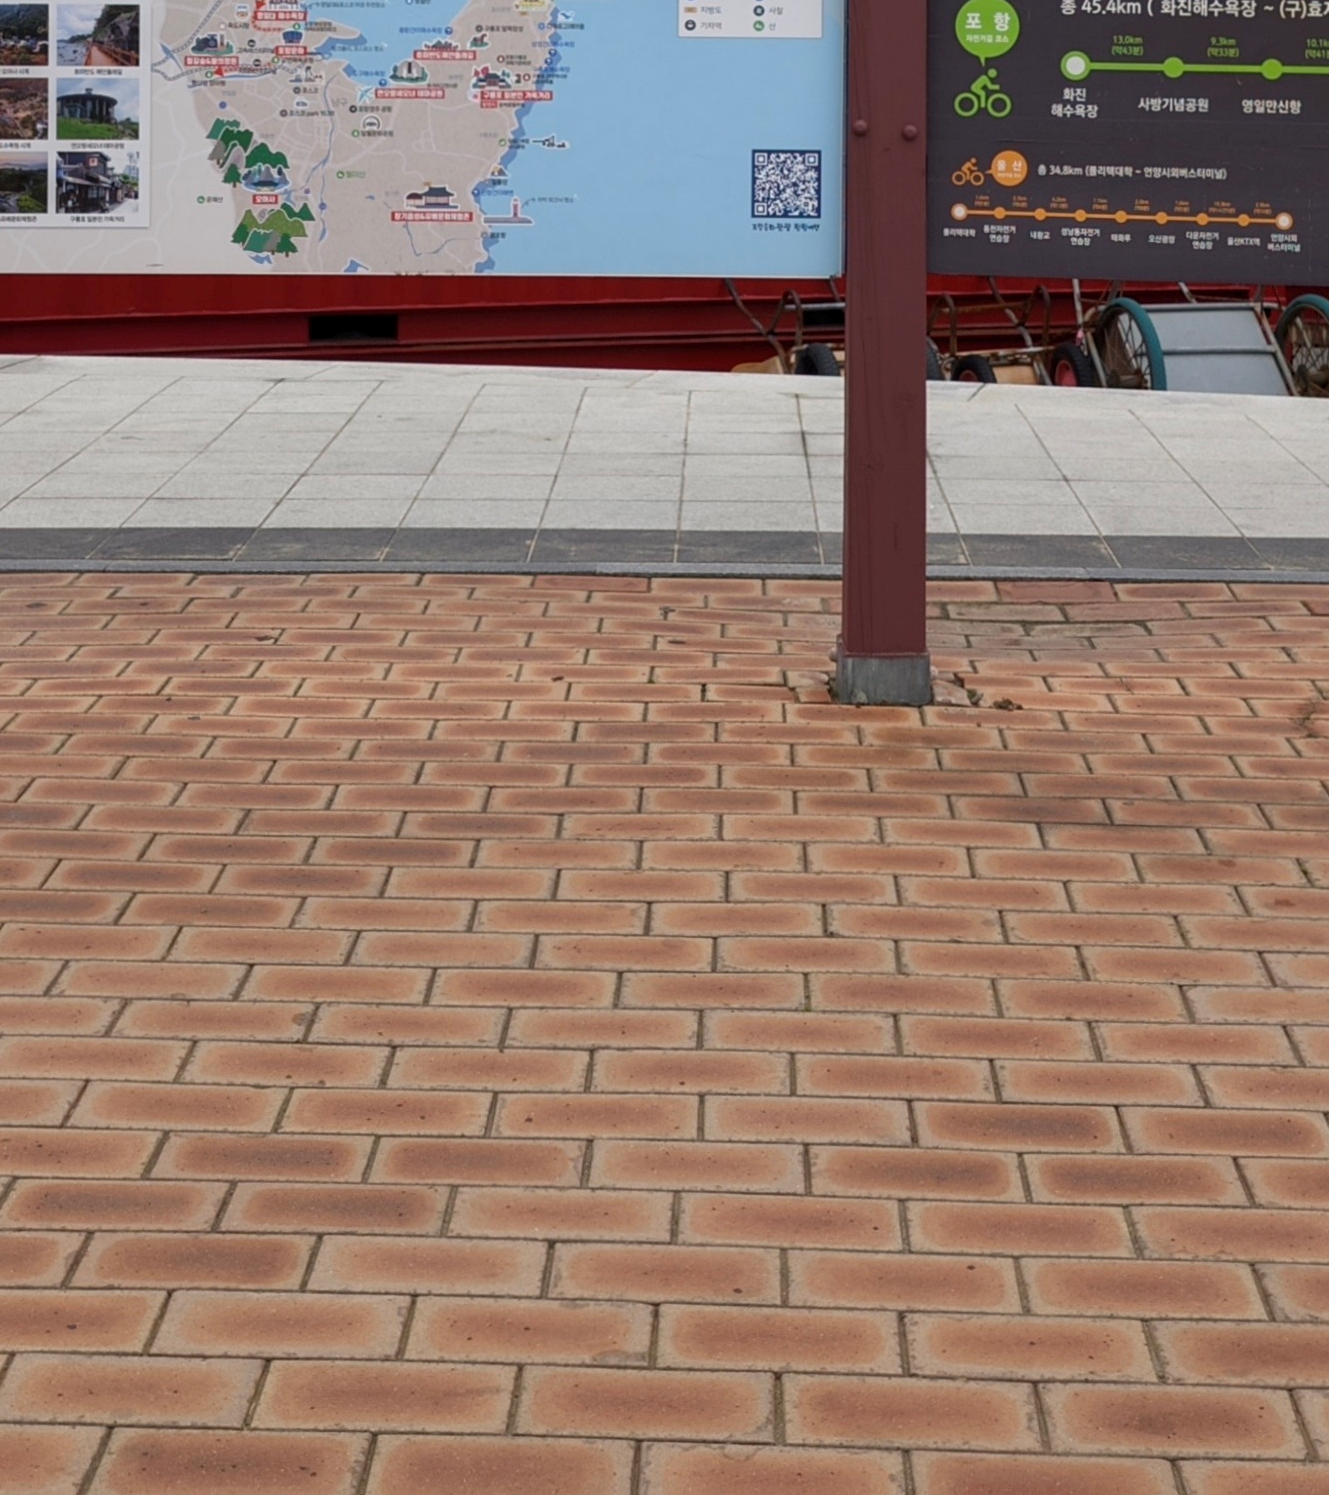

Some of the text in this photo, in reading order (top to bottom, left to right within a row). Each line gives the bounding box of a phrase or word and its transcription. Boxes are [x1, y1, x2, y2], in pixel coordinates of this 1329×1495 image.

[700, 6, 722, 14] 지방도
[700, 21, 722, 30] 기차역
[1062, 88, 1087, 102] 화진
[1050, 104, 1098, 119] 해수욕장
[1138, 97, 1209, 112] 사방기념공원
[1242, 99, 1301, 114] 영일만신항
[1037, 165, 1227, 180] 총 34.8km (폴리텍대학 언양시외버스터미널)
